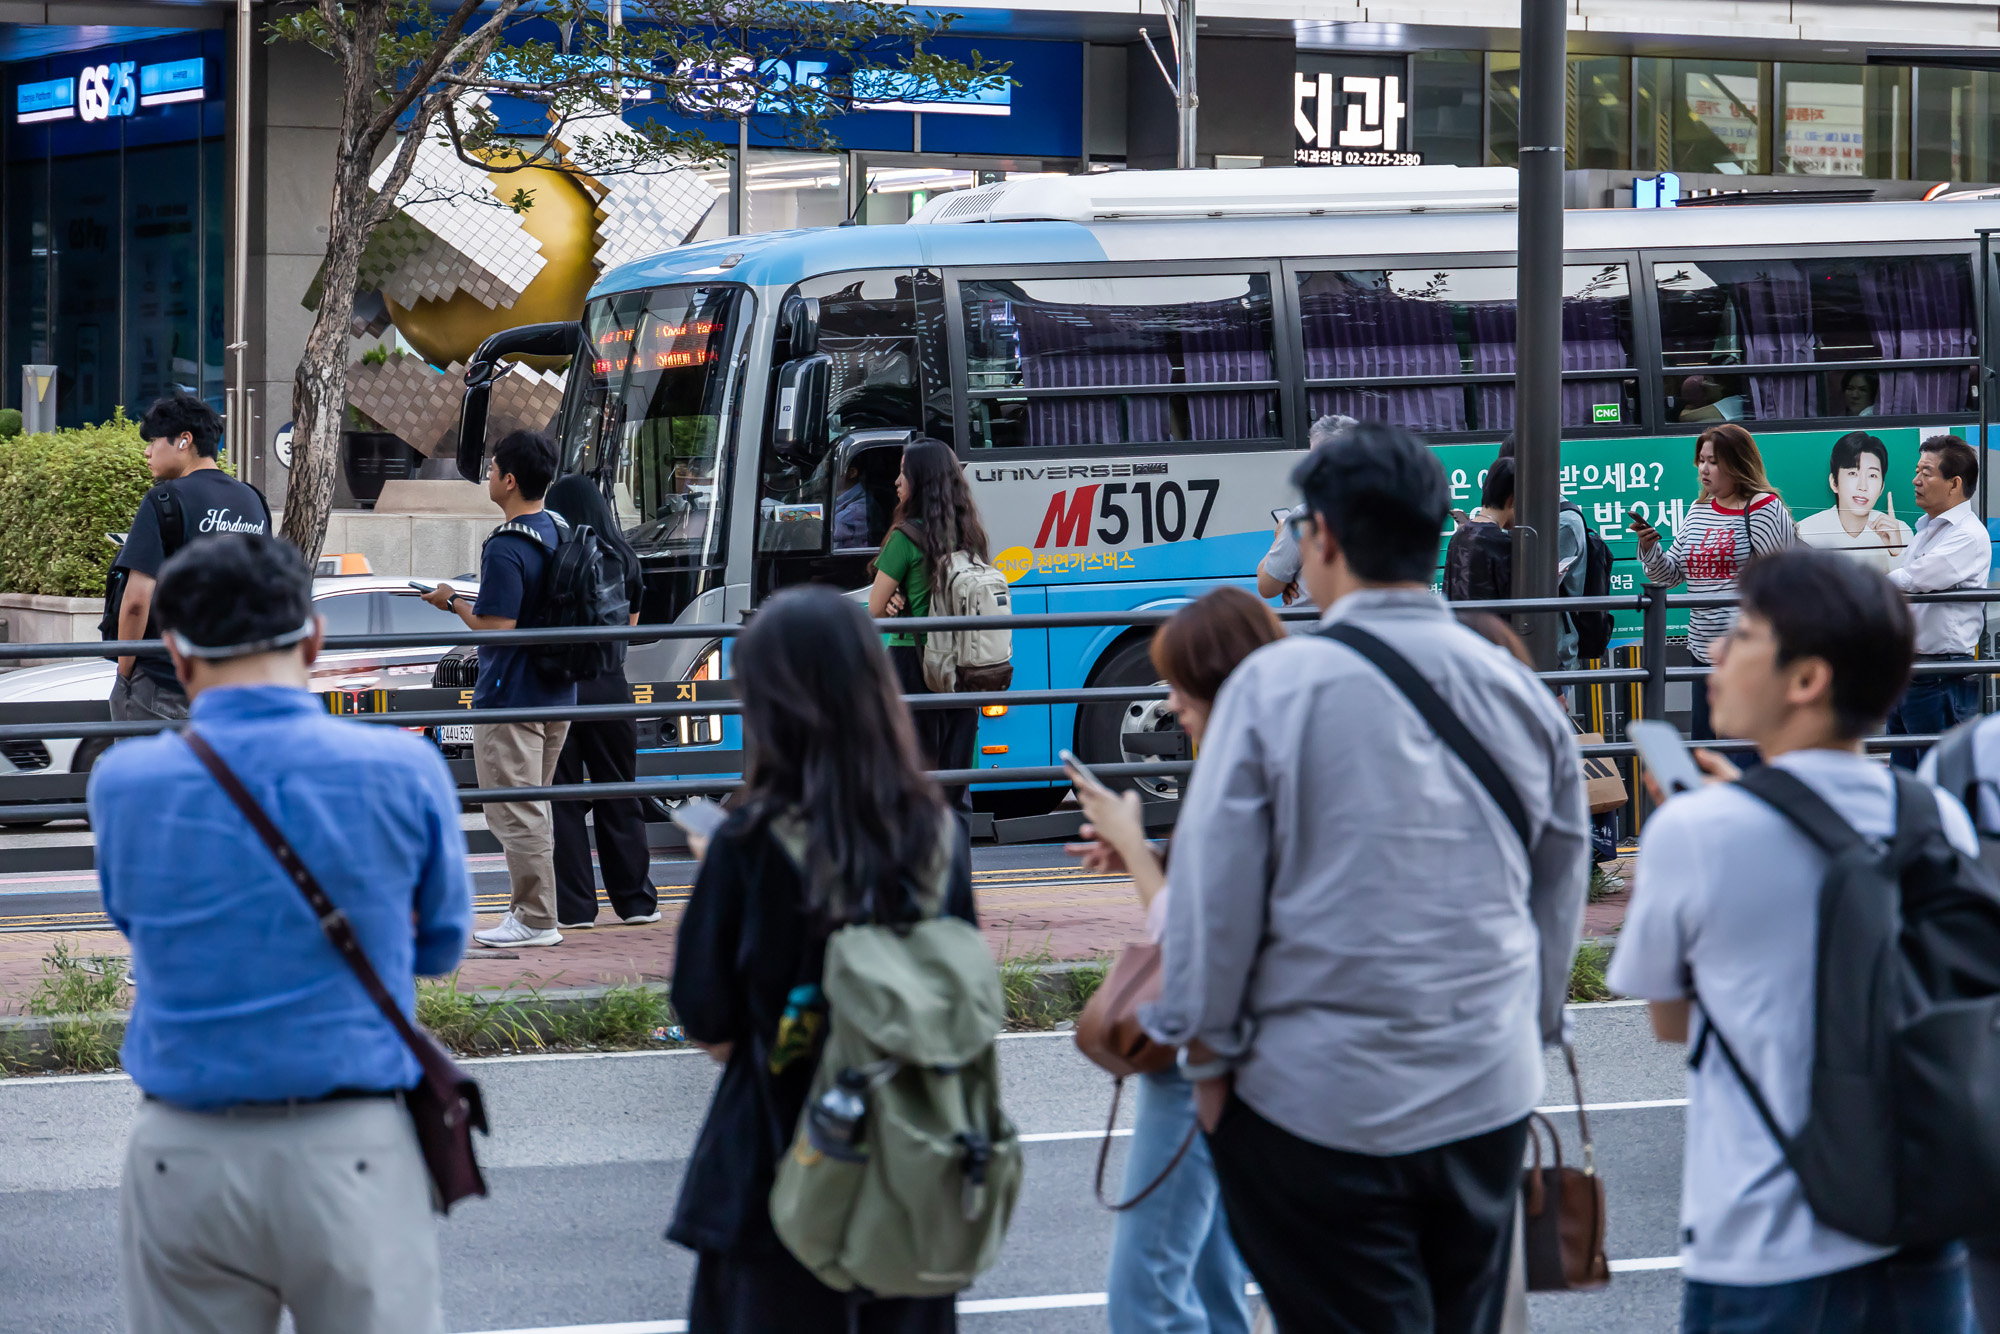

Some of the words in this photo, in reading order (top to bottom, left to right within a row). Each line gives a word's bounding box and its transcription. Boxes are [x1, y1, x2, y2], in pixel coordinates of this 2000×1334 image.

[79, 61, 136, 122] GS25
[1345, 152, 1421, 166] 02-2275-2580
[1595, 408, 1618, 418] CNG
[1559, 462, 1665, 496] 받으세요?
[198, 508, 265, 536] Hardwood
[1033, 478, 1220, 549] M5107
[994, 558, 1030, 572] CNG
[1037, 551, 1136, 574] 천연가스버스
[1610, 574, 1634, 590] 연금
[460, 725, 474, 741] 552
